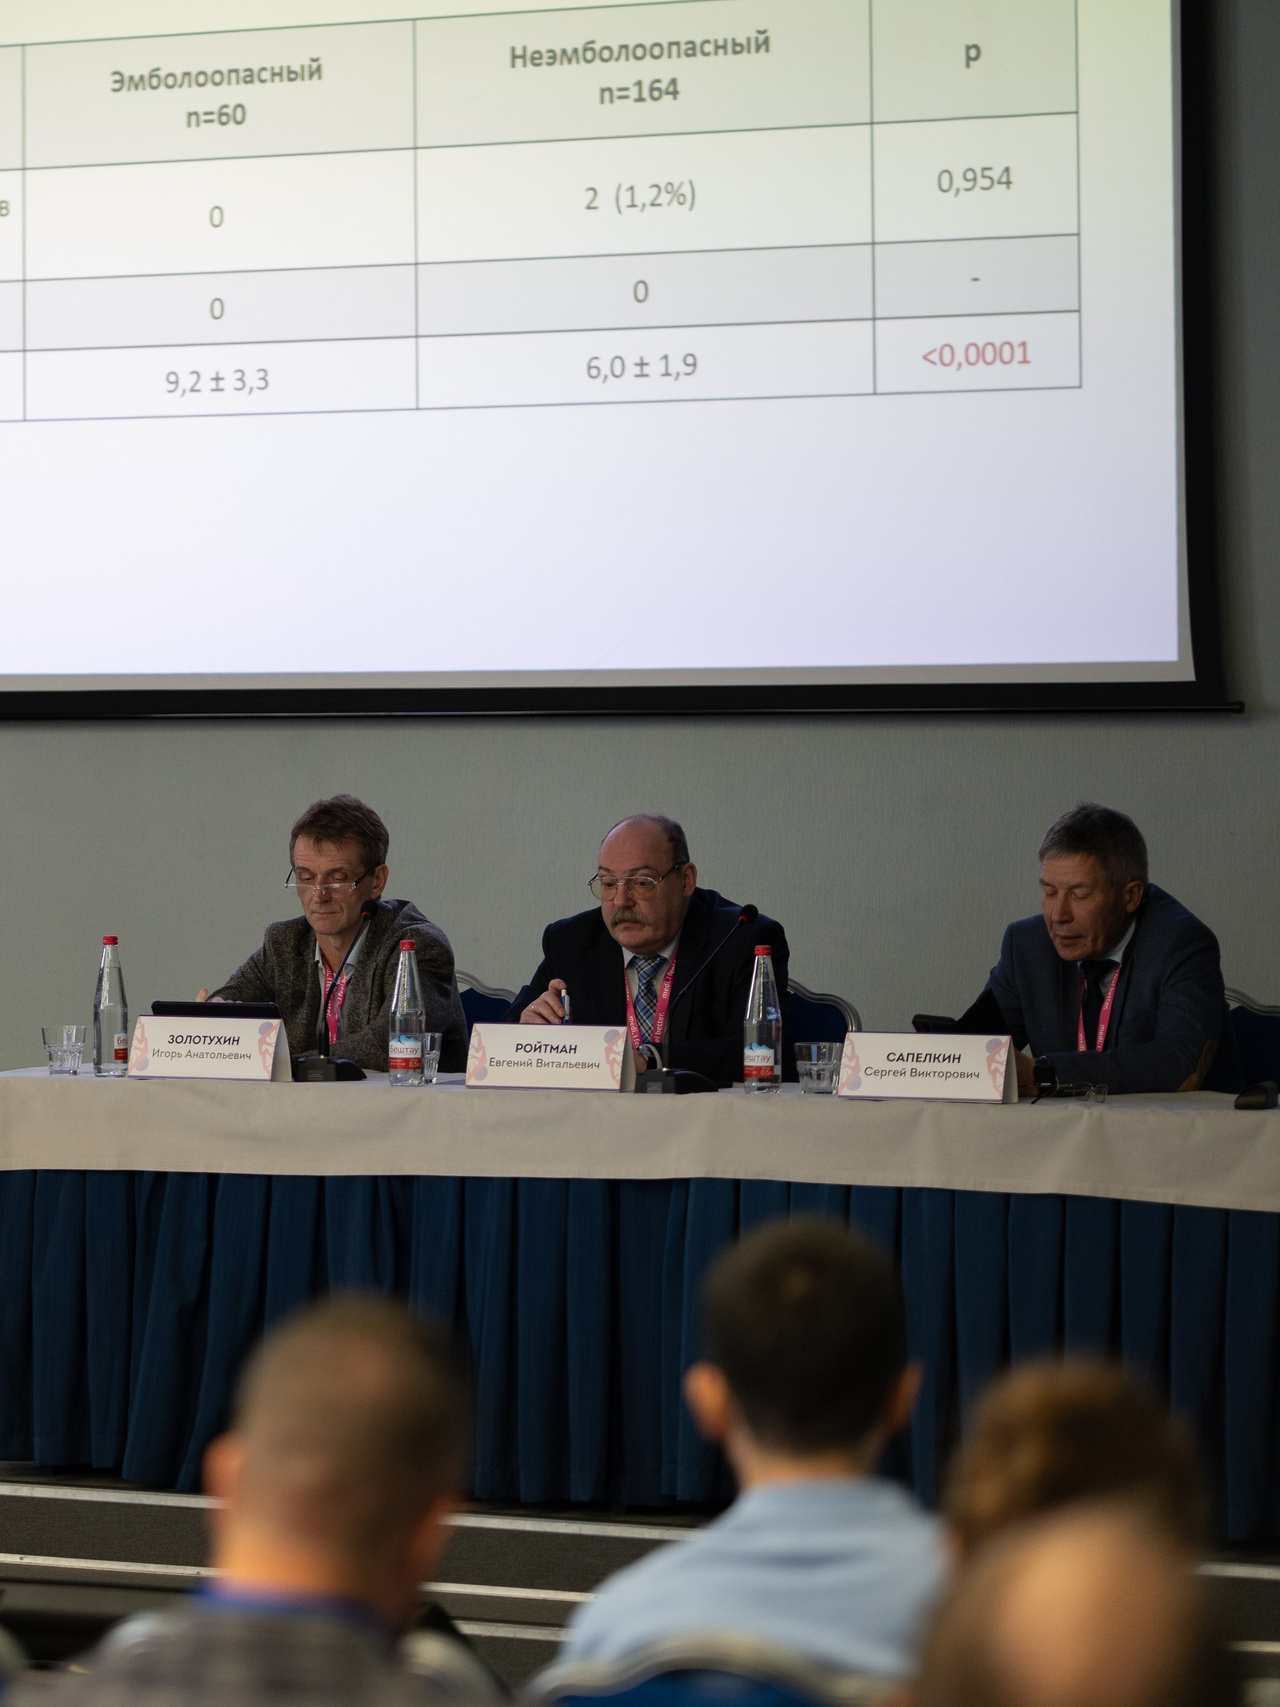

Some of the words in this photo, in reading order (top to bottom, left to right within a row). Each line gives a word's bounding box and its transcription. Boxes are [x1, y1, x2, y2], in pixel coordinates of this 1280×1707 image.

[510, 29, 771, 69] Неэмболоопасный
[110, 57, 323, 93] Эмболоопасный
[599, 78, 681, 105] n=164
[186, 103, 247, 129] n=60
[937, 166, 1014, 198] 0,954
[584, 186, 600, 211] 2
[615, 180, 697, 215] (1,2%)
[209, 205, 225, 229] 0
[633, 279, 650, 304] 0
[209, 297, 225, 321] 0
[586, 355, 626, 384] 6,0
[659, 353, 698, 382] 1,9
[921, 340, 1032, 373] <0,0001
[165, 370, 202, 398] 9,2
[233, 367, 270, 396] 3,3
[167, 1034, 241, 1046] ЗОЛОТУХИН
[515, 1041, 578, 1055] РОЙТМАН
[151, 1048, 183, 1061] Игорь
[184, 1049, 252, 1060] Анатольевич
[488, 1057, 533, 1069] Евгений
[535, 1058, 601, 1069] Витальевич
[886, 1051, 962, 1064] САПЕЛКИН
[864, 1066, 907, 1080] Сергей
[909, 1067, 980, 1081] Викторович
